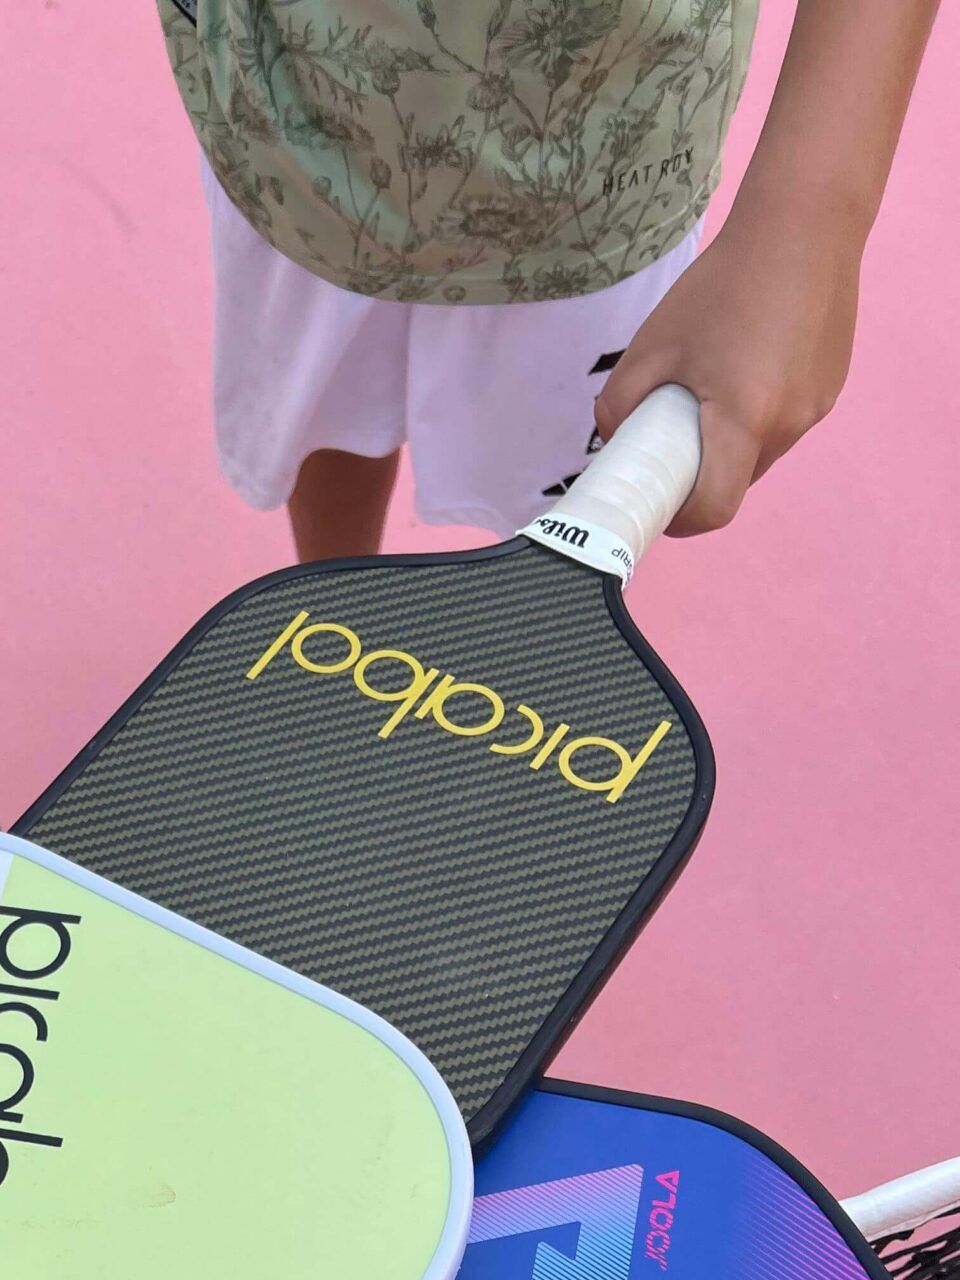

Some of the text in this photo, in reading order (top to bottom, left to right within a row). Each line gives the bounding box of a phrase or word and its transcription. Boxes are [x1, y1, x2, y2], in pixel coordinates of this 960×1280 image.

[602, 169, 653, 196] HEAT
[246, 610, 672, 804] picabol
[645, 1170, 680, 1271] JOOLA
